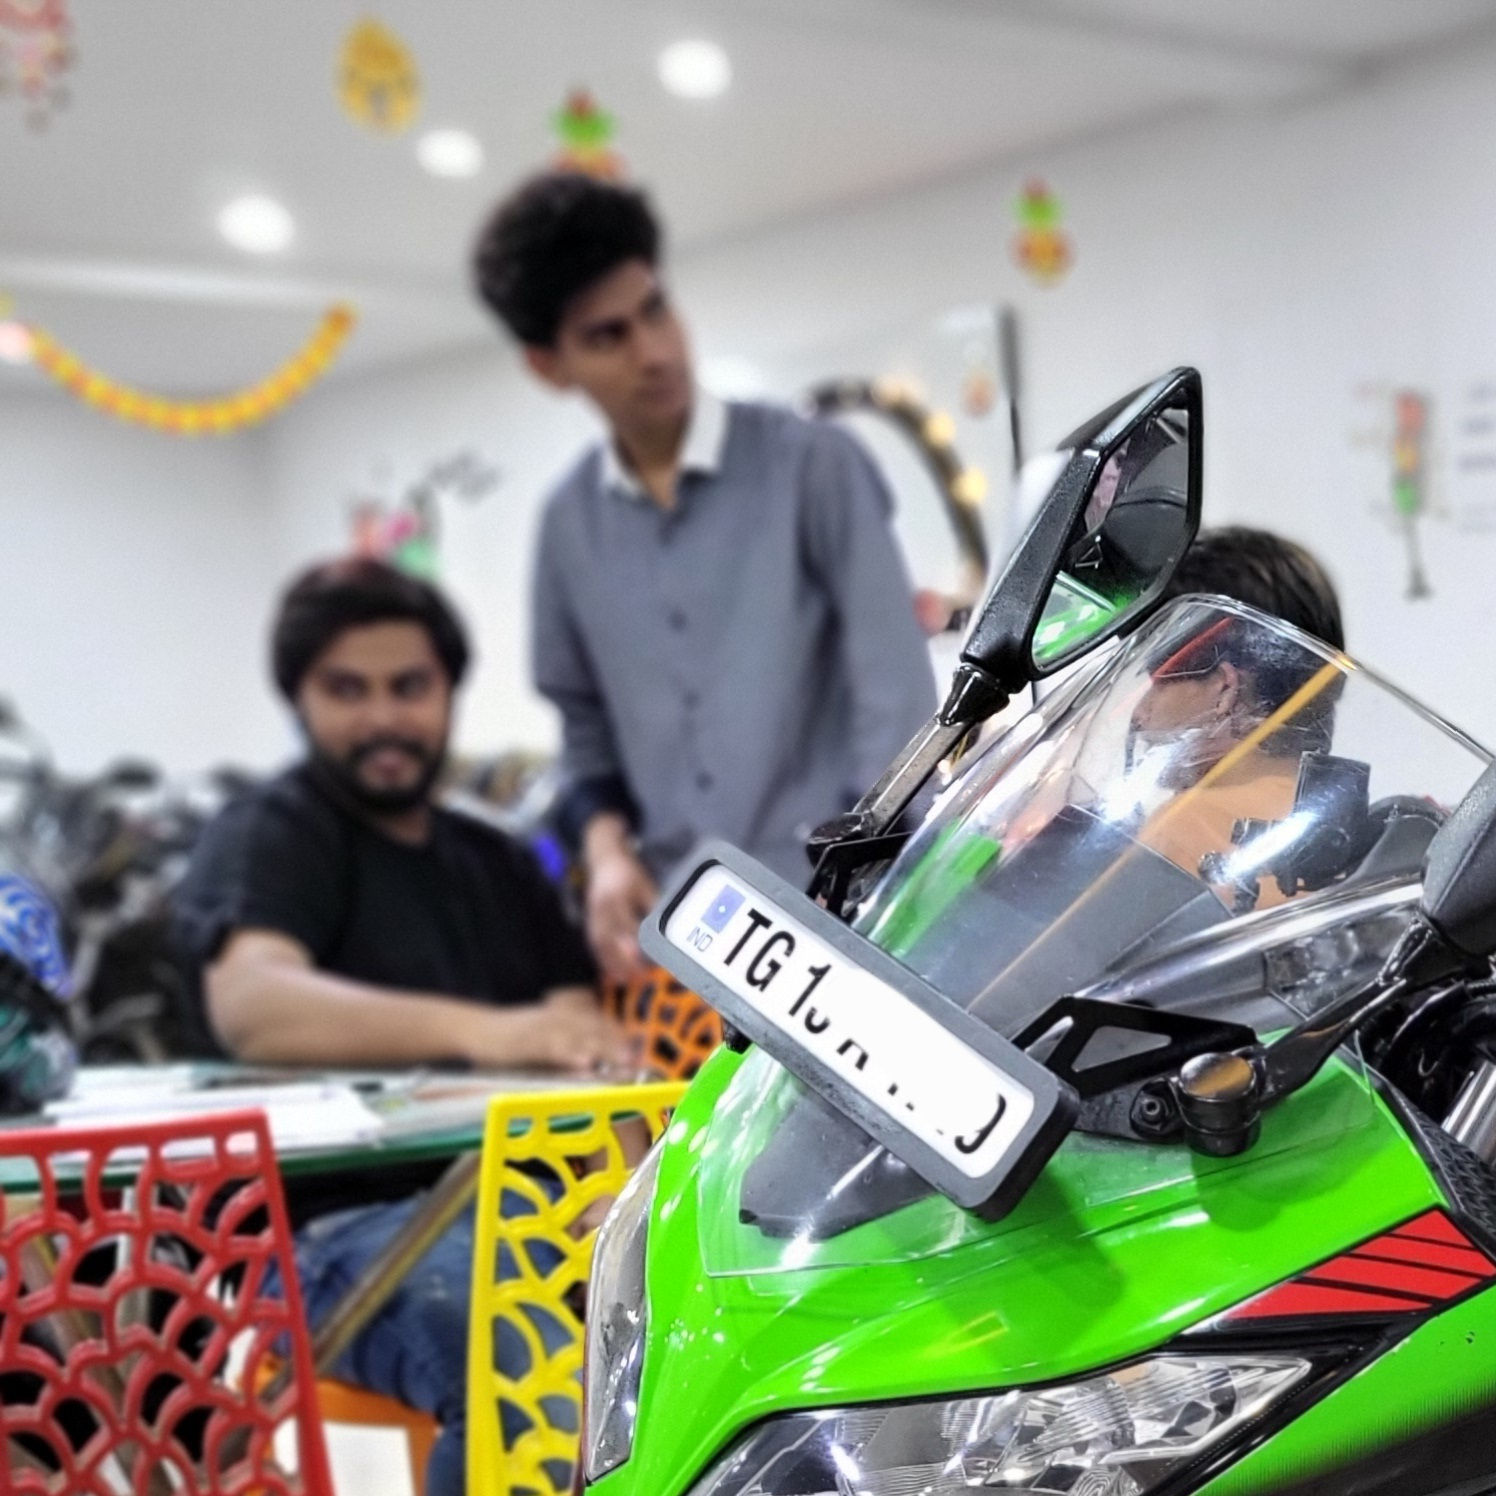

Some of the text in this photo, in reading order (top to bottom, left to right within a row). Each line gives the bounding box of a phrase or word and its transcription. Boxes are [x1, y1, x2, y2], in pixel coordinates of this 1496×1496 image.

[687, 926, 714, 952] IND
[723, 908, 832, 1034] TG 1
